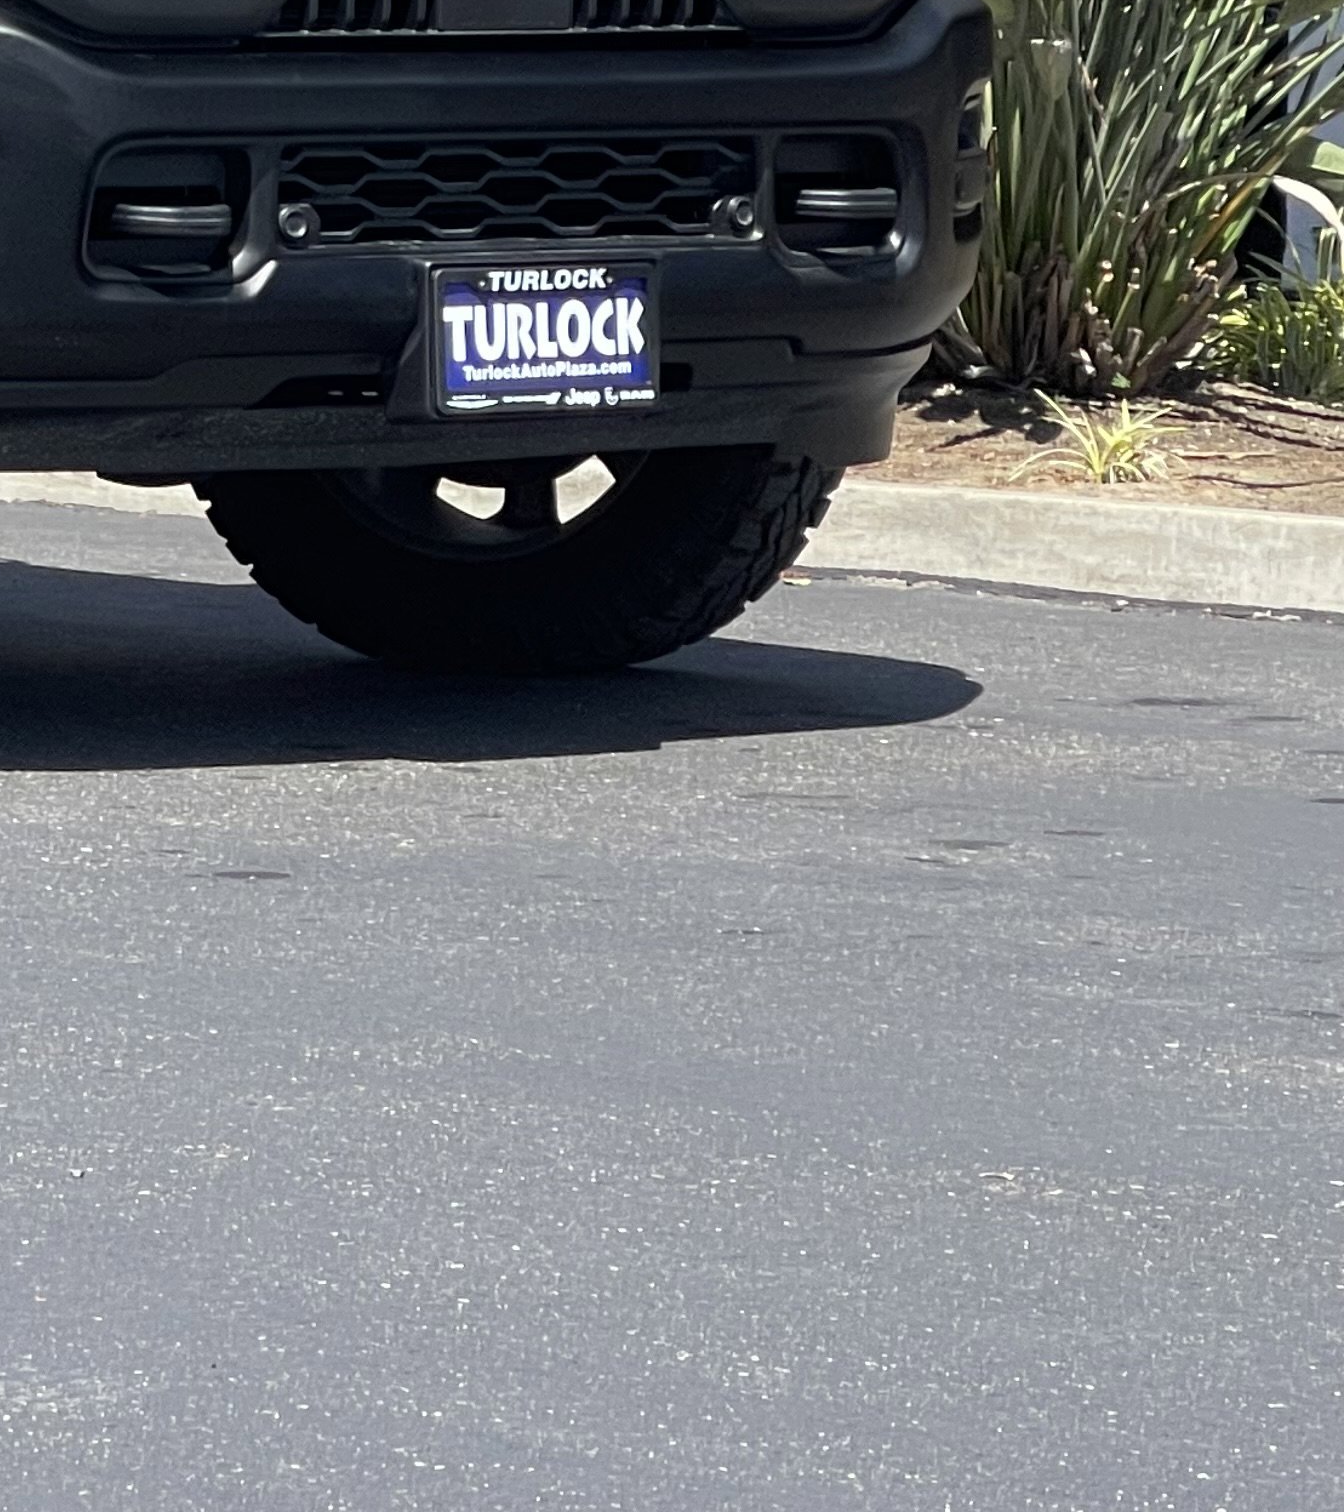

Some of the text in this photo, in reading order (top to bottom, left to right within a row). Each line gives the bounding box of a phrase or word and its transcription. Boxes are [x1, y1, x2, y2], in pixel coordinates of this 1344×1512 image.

[487, 267, 608, 292] TURLOCK
[442, 296, 646, 363] TURLOCK
[462, 361, 633, 383] TurlockAutoPlaza.com
